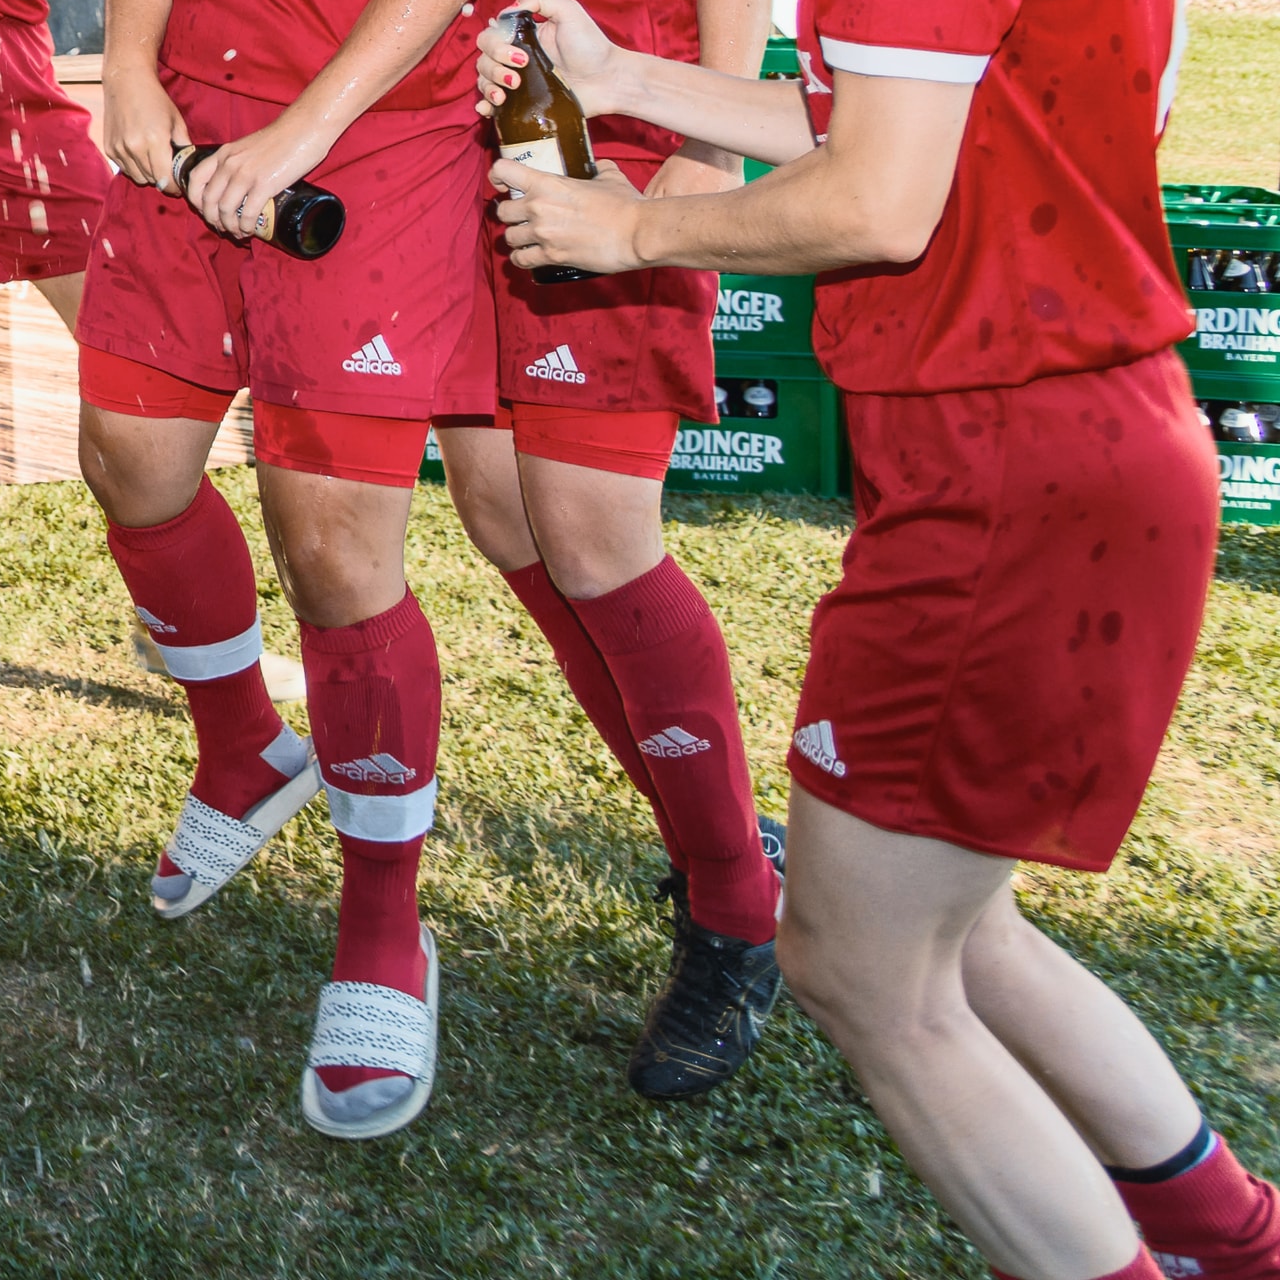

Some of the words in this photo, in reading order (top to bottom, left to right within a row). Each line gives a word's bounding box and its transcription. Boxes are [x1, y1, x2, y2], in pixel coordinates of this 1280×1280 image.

[342, 359, 401, 376] adidas
[526, 364, 586, 385] adidas
[670, 455, 765, 474] BRAUHAUS
[692, 472, 739, 482] BAYERN
[638, 738, 712, 759] adidas
[329, 748, 417, 785] adidas
